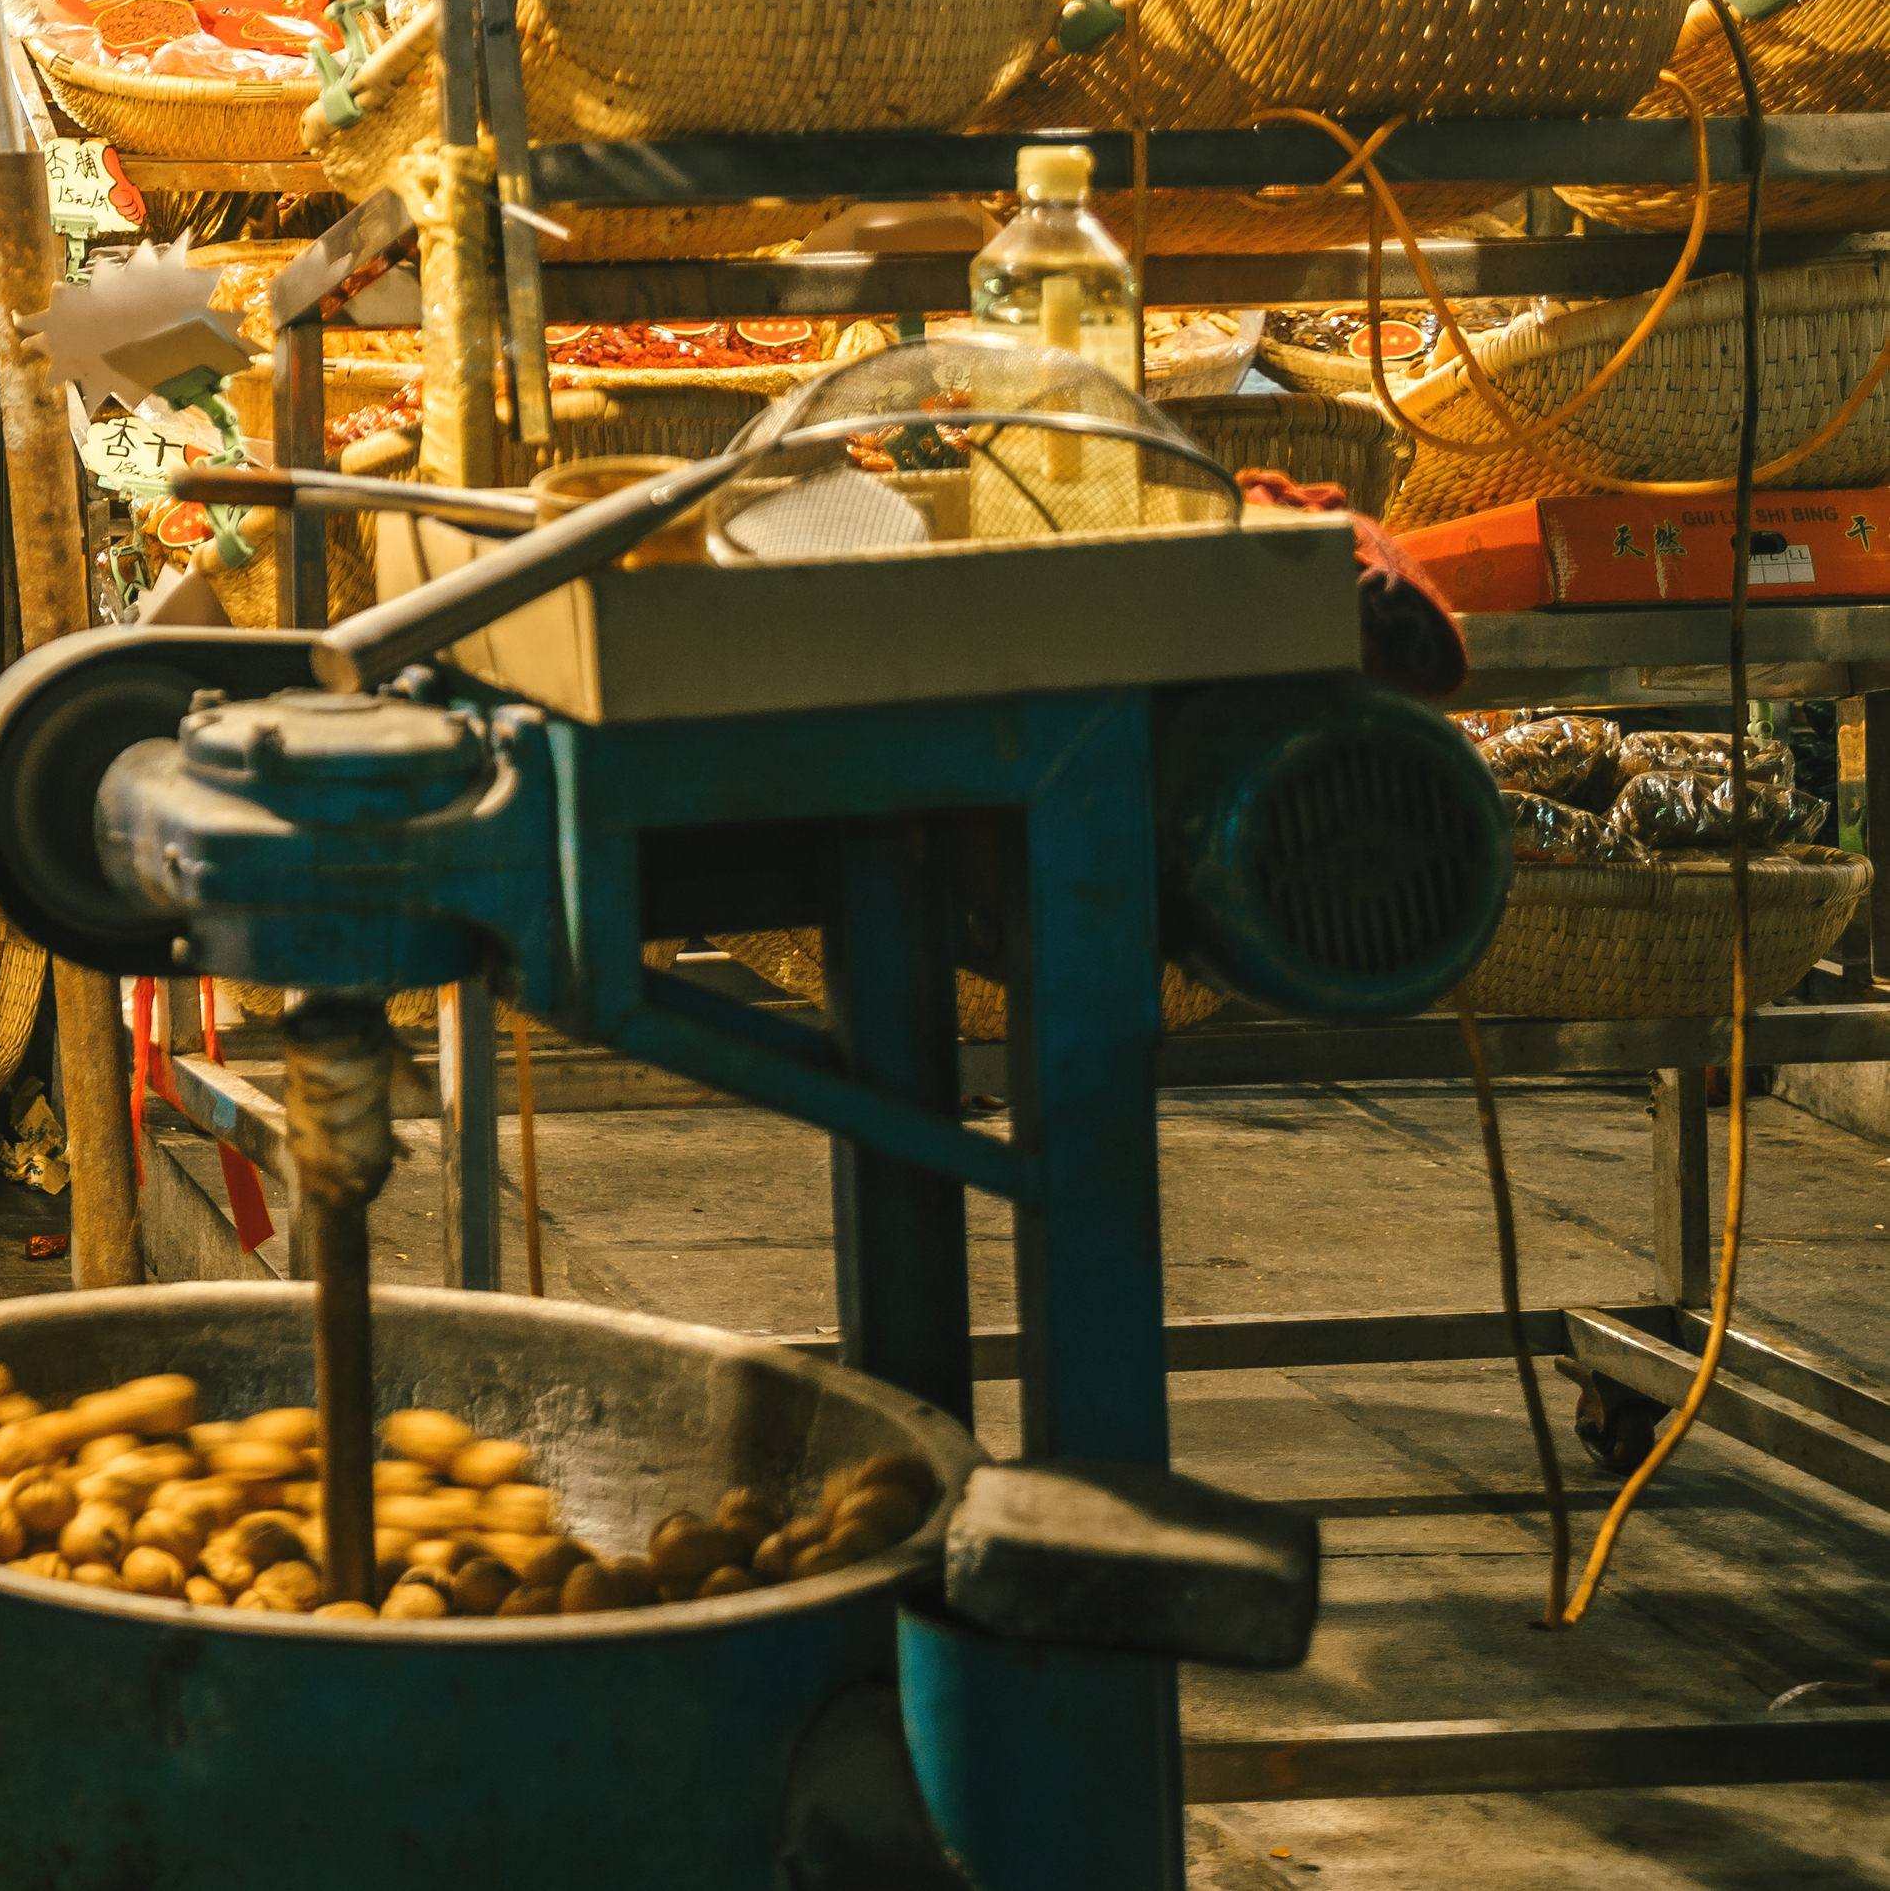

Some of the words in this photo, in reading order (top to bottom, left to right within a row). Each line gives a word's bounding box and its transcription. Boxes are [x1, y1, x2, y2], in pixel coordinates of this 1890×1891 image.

[102, 419, 183, 467] 杏干
[1682, 510, 1715, 527] GUI
[1793, 506, 1839, 523] BING
